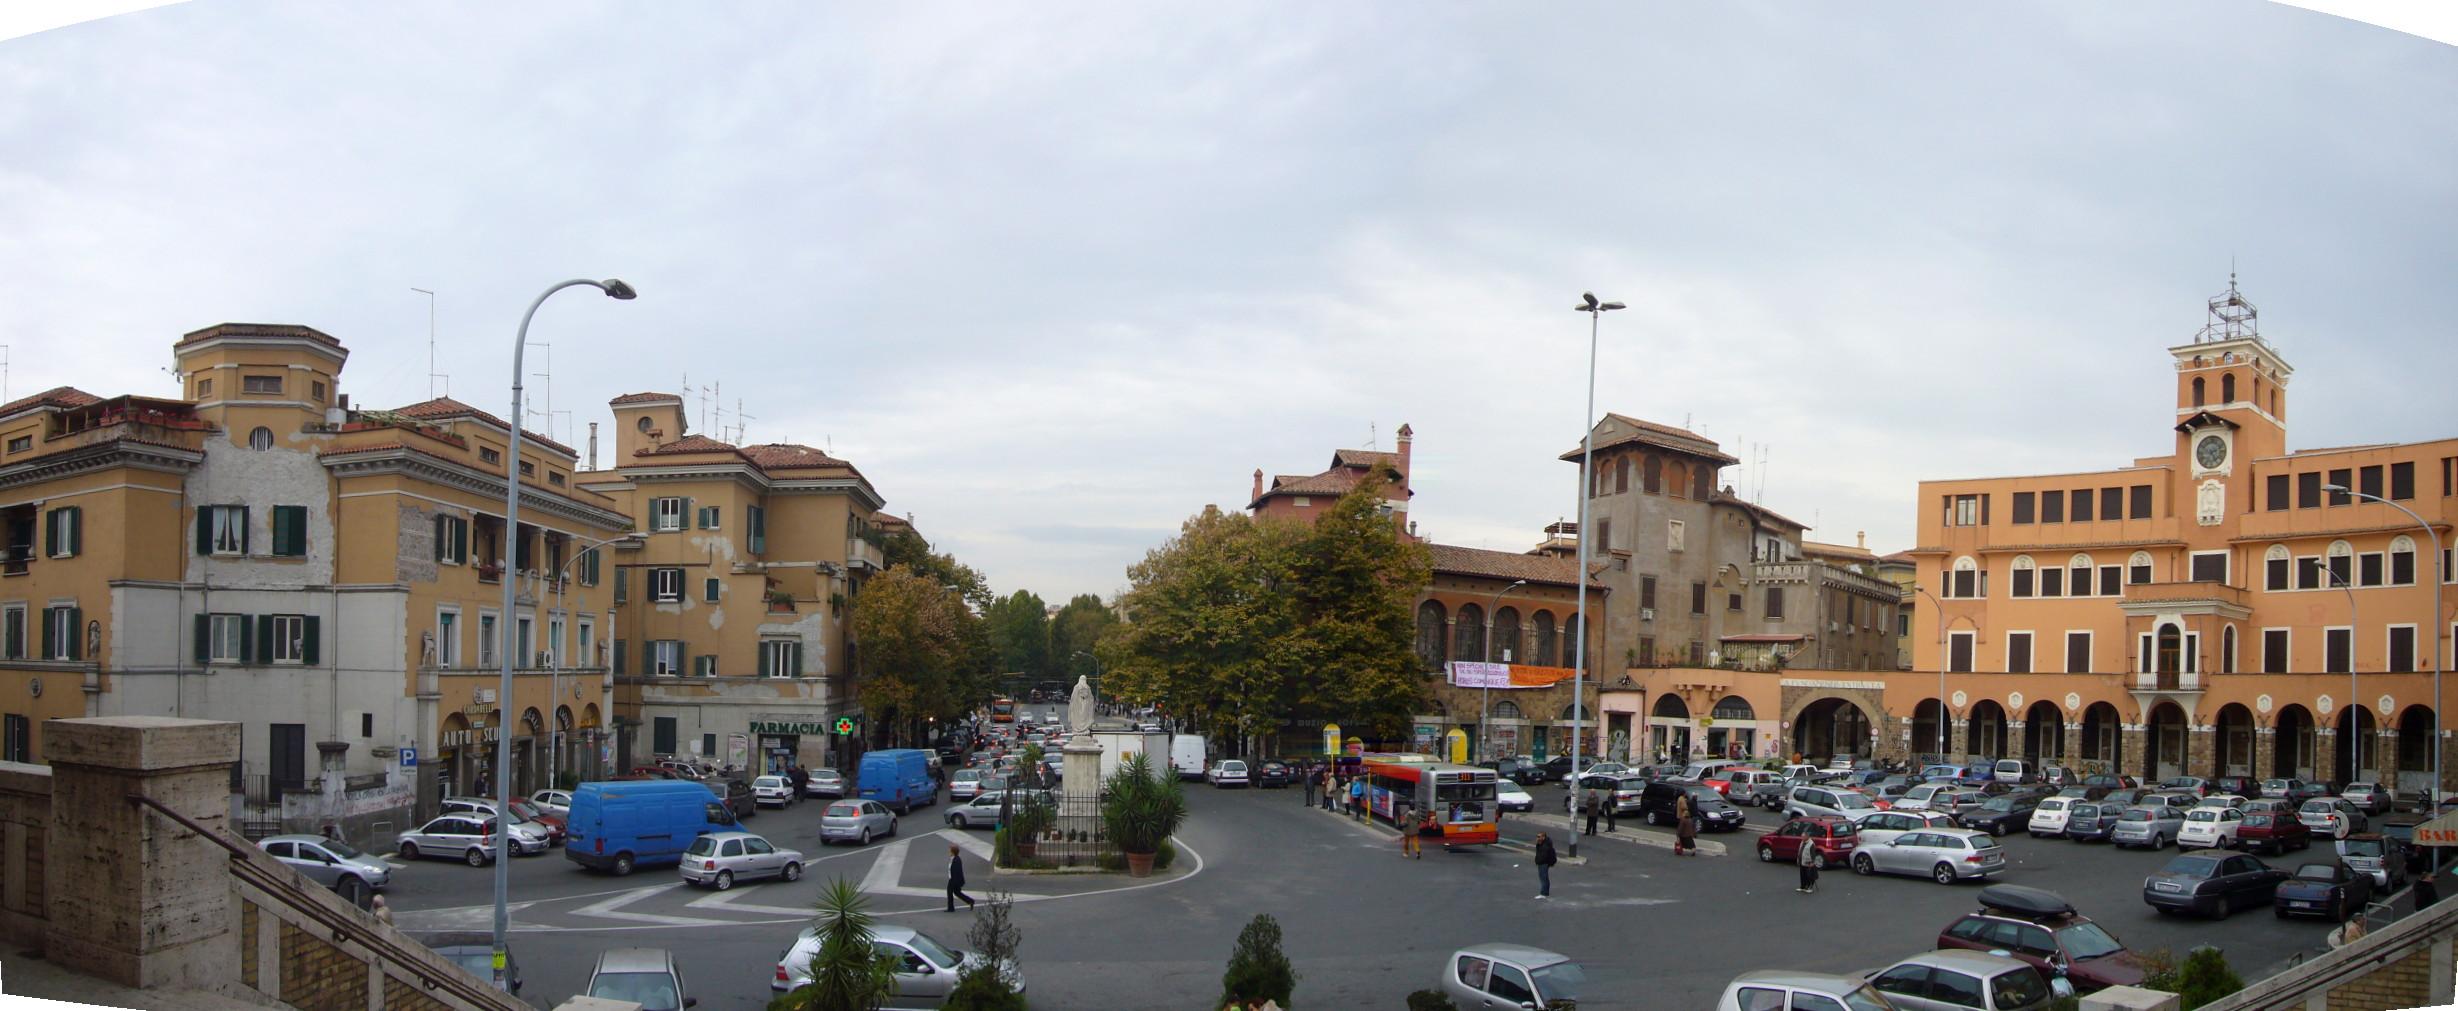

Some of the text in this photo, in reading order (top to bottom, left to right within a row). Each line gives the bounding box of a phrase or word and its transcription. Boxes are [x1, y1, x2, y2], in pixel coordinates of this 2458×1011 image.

[750, 722, 824, 735] FARMACIA
[443, 727, 501, 747] AUTO SCU
[402, 750, 415, 766] P
[2420, 828, 2457, 841] BAR
